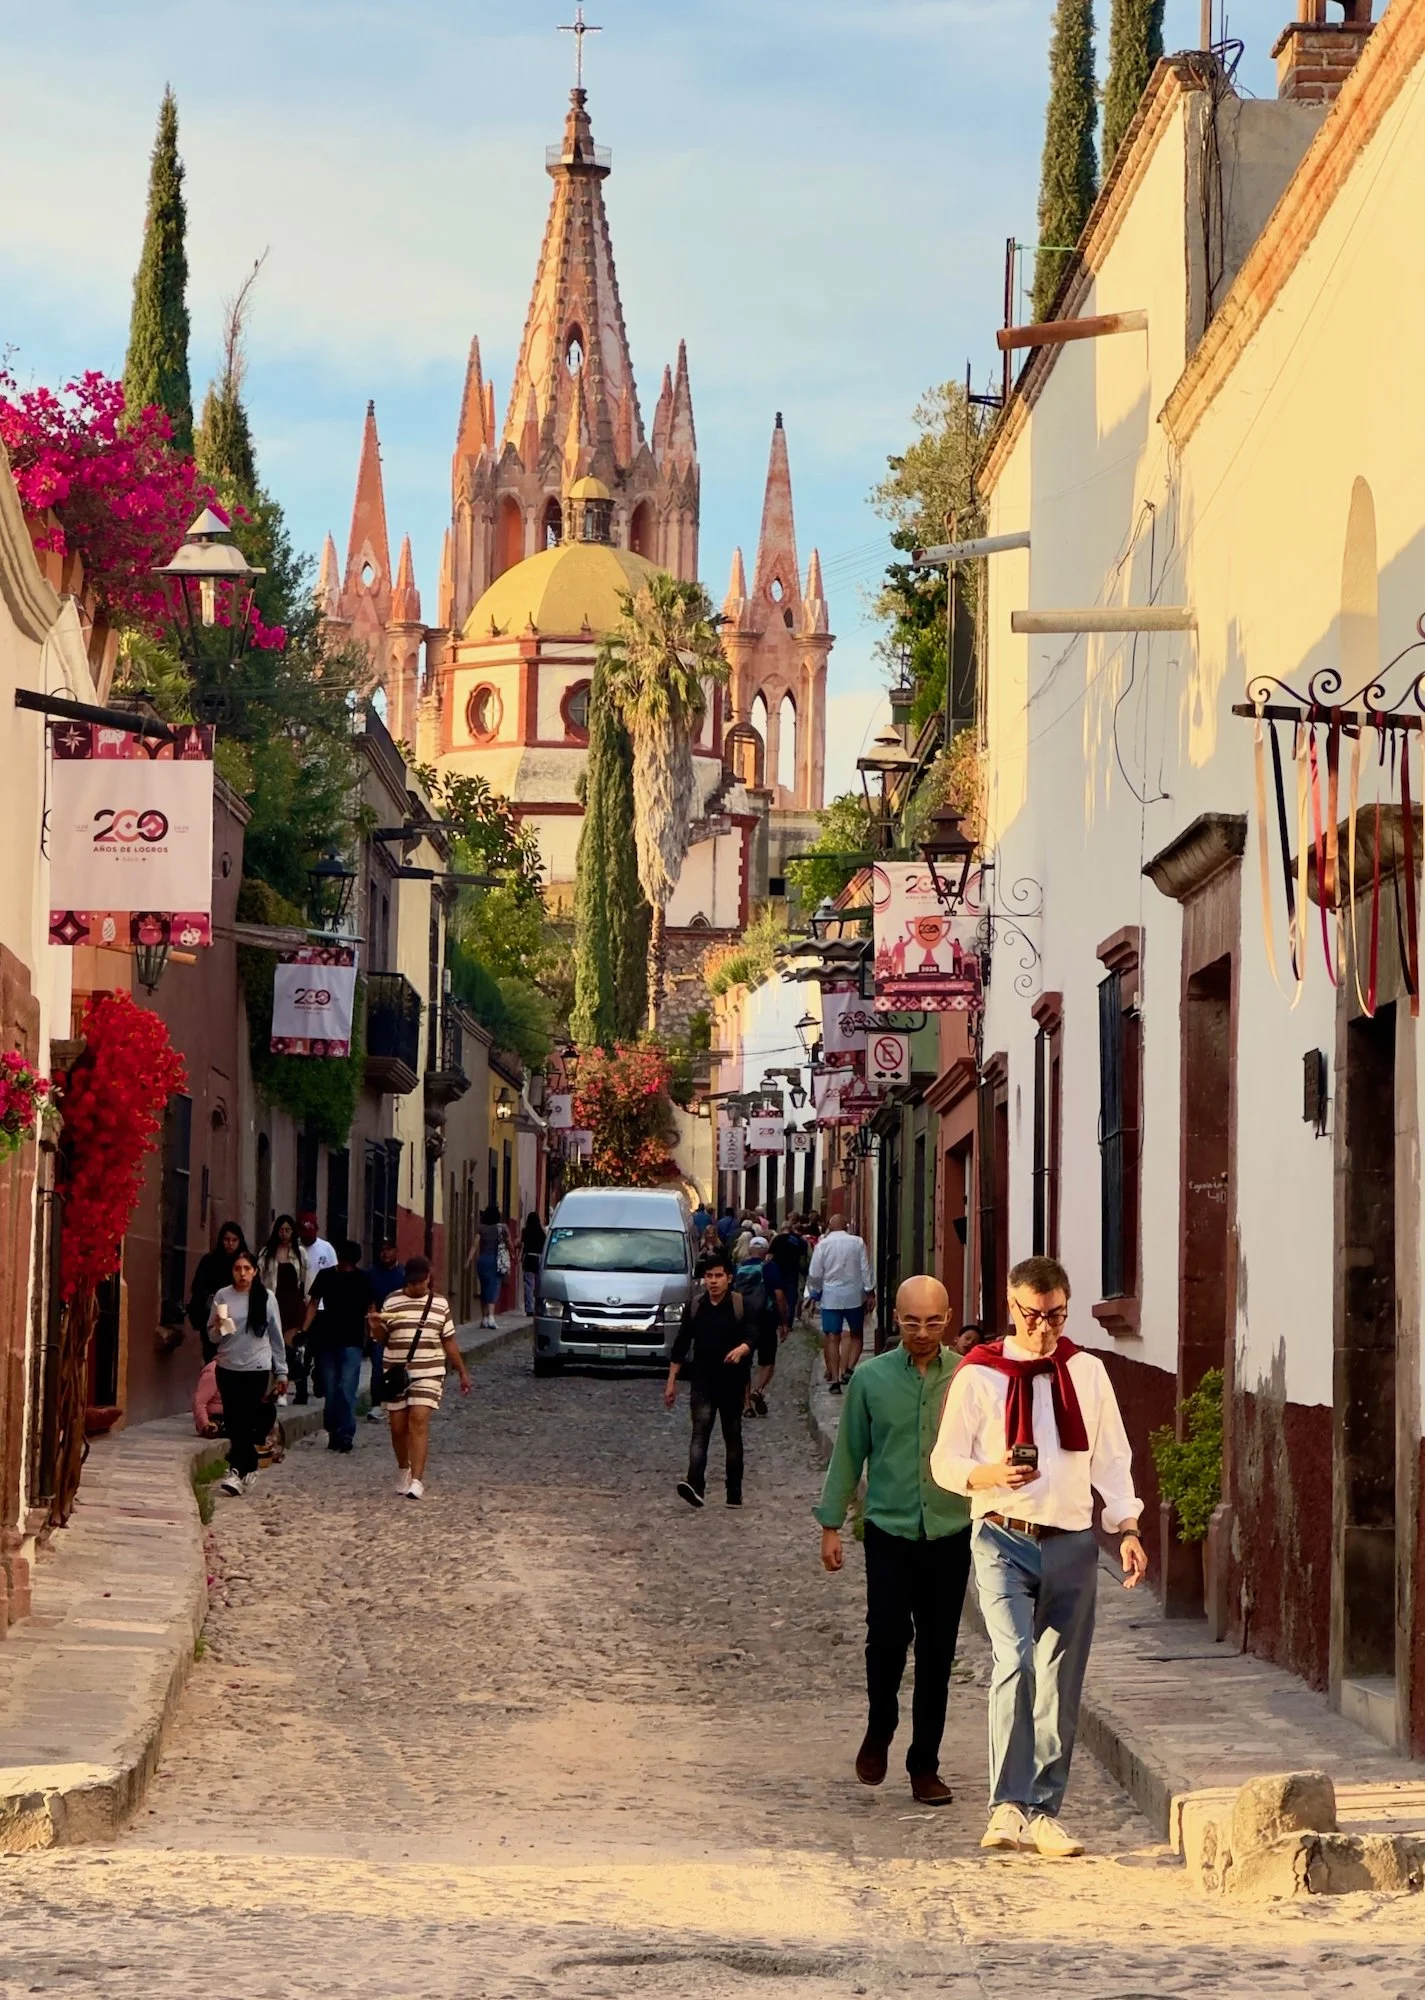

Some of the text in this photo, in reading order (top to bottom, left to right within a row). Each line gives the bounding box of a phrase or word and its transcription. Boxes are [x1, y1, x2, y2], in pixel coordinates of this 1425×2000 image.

[93, 809, 168, 842] 200
[93, 845, 117, 853] AÑOS
[294, 988, 331, 1005] 200
